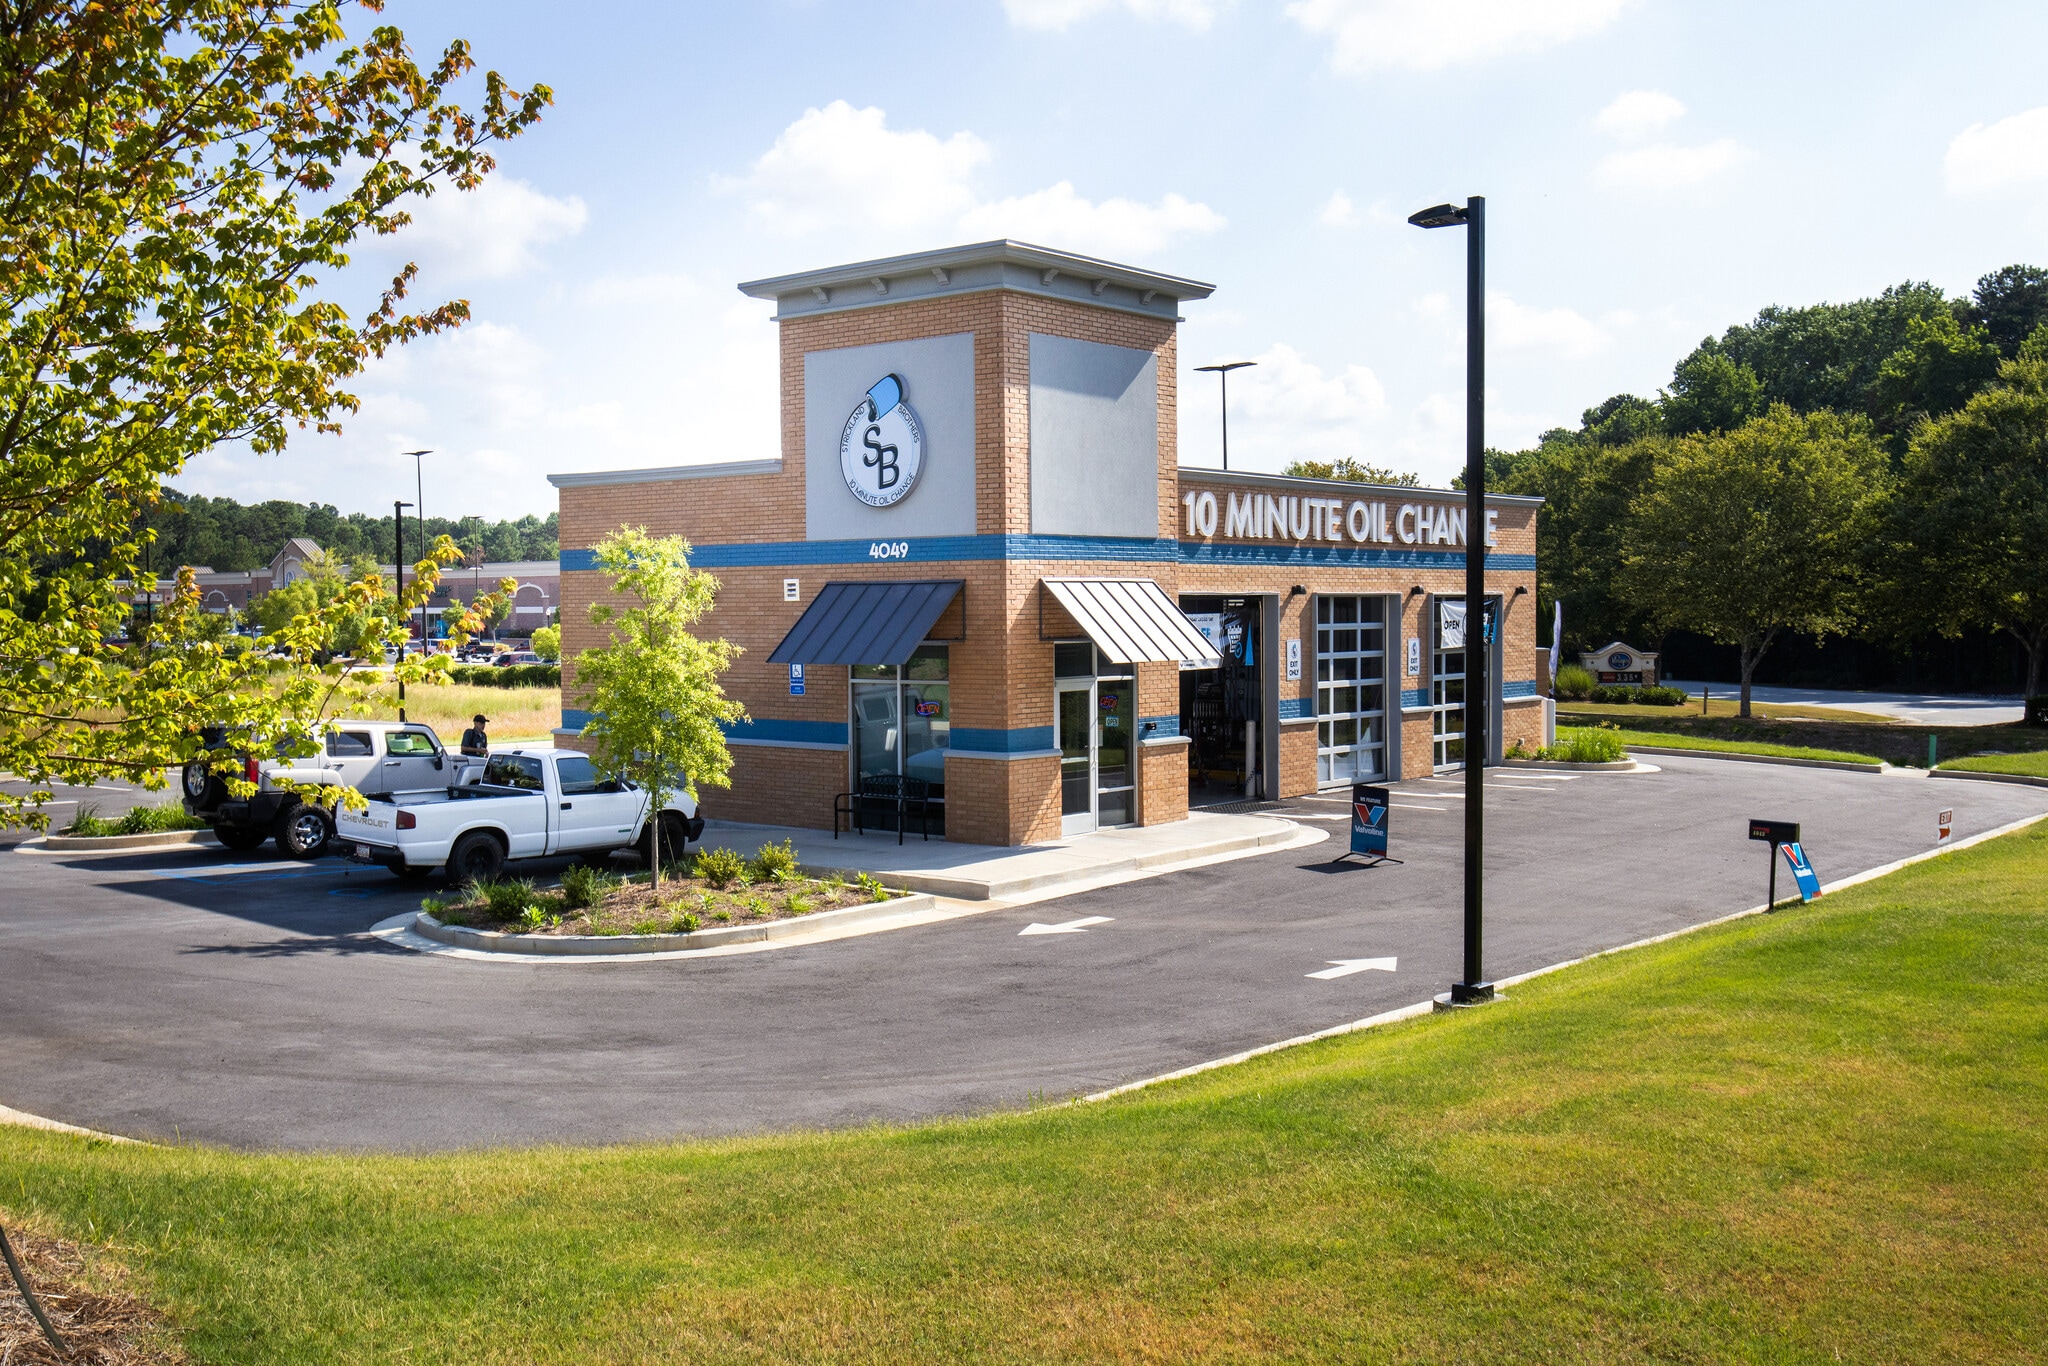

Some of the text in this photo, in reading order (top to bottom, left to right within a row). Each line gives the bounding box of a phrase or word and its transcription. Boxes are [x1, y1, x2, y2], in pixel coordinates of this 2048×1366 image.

[842, 405, 920, 453] STRICKLAND BROTHERS
[849, 472, 915, 505] 10 MINUTE OIL CHANGE
[1182, 490, 1498, 547] 10 MINUTE OIL CHANE
[869, 542, 909, 559] 4049
[1444, 620, 1460, 630] OPEN
[1290, 660, 1298, 668] EXIT
[916, 703, 940, 715] OPEN
[1106, 718, 1118, 726] OPEN
[342, 814, 389, 828] CHEVROLET
[1354, 825, 1384, 836] Valvoline
